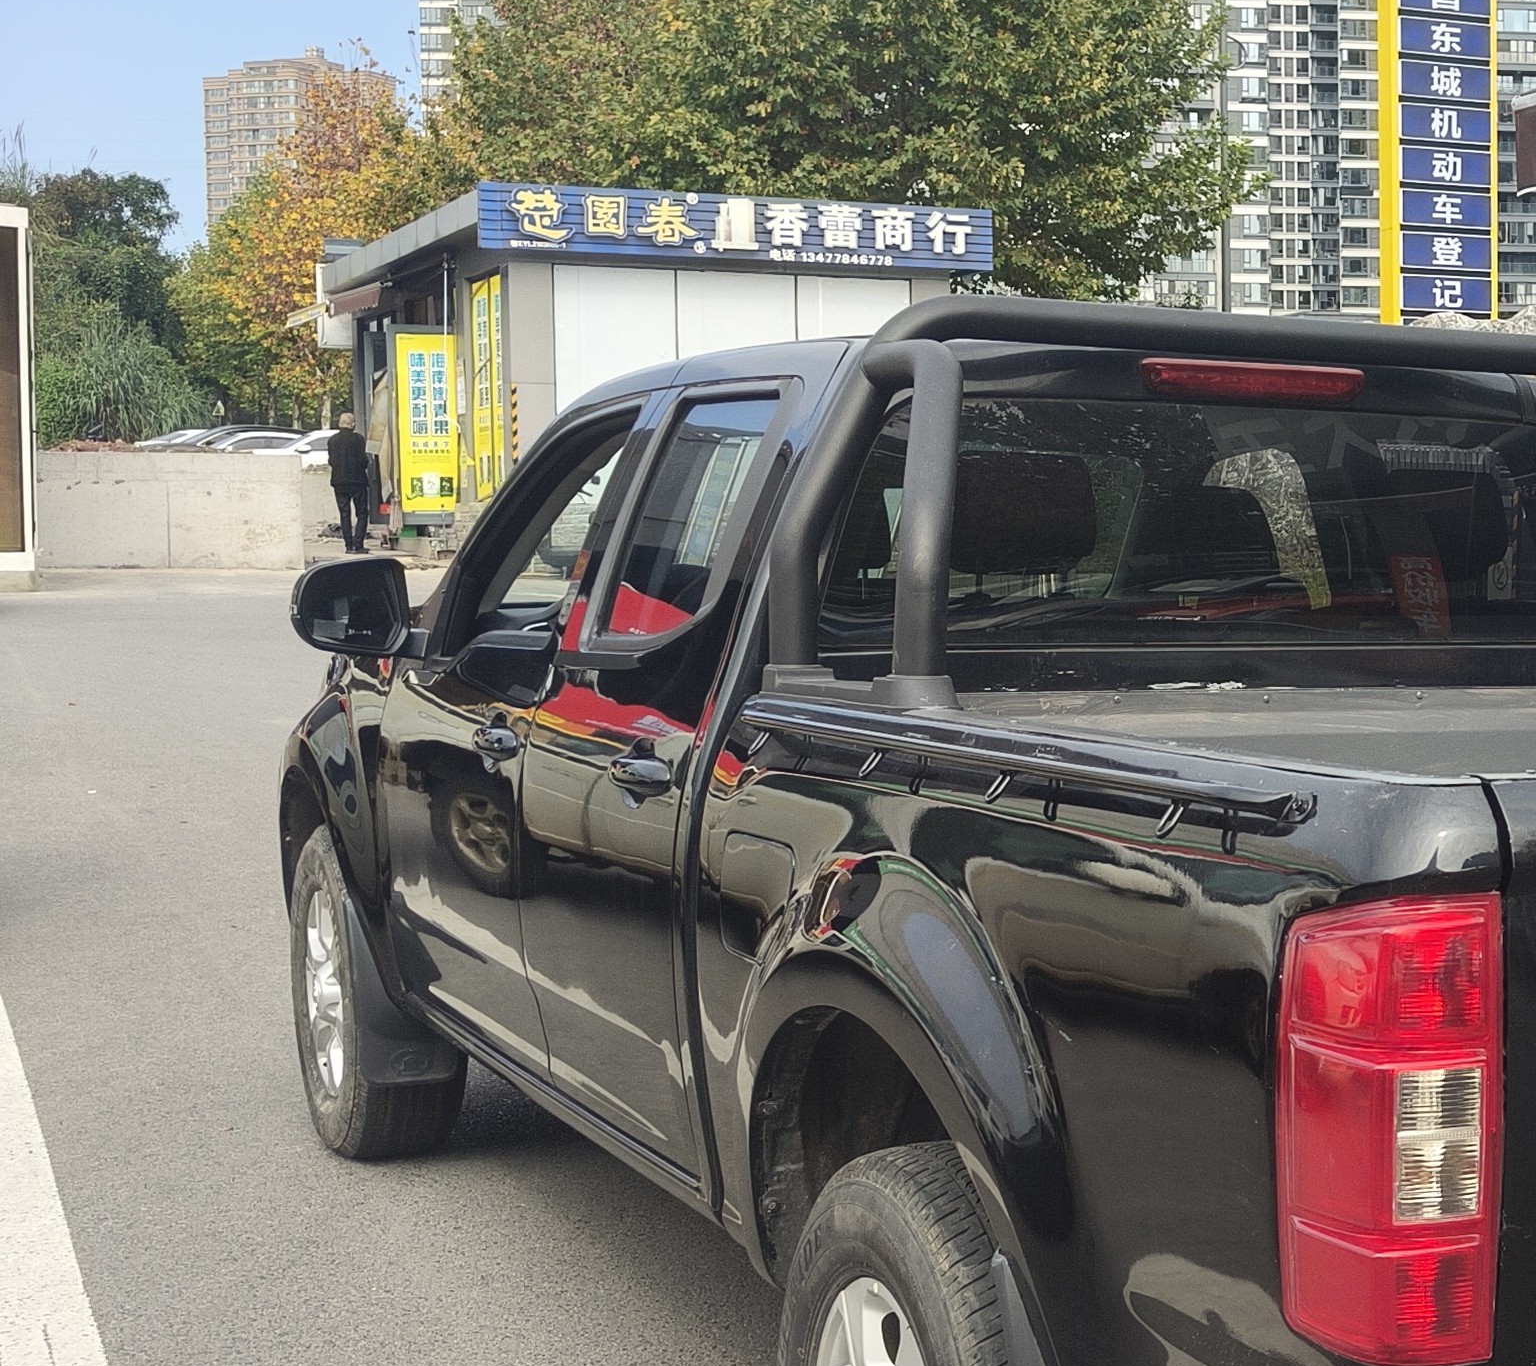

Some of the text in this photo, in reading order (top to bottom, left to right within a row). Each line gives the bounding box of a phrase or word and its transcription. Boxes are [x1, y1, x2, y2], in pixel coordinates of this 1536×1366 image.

[764, 201, 973, 256] 香蕾商行
[800, 252, 894, 267] 13477846778
